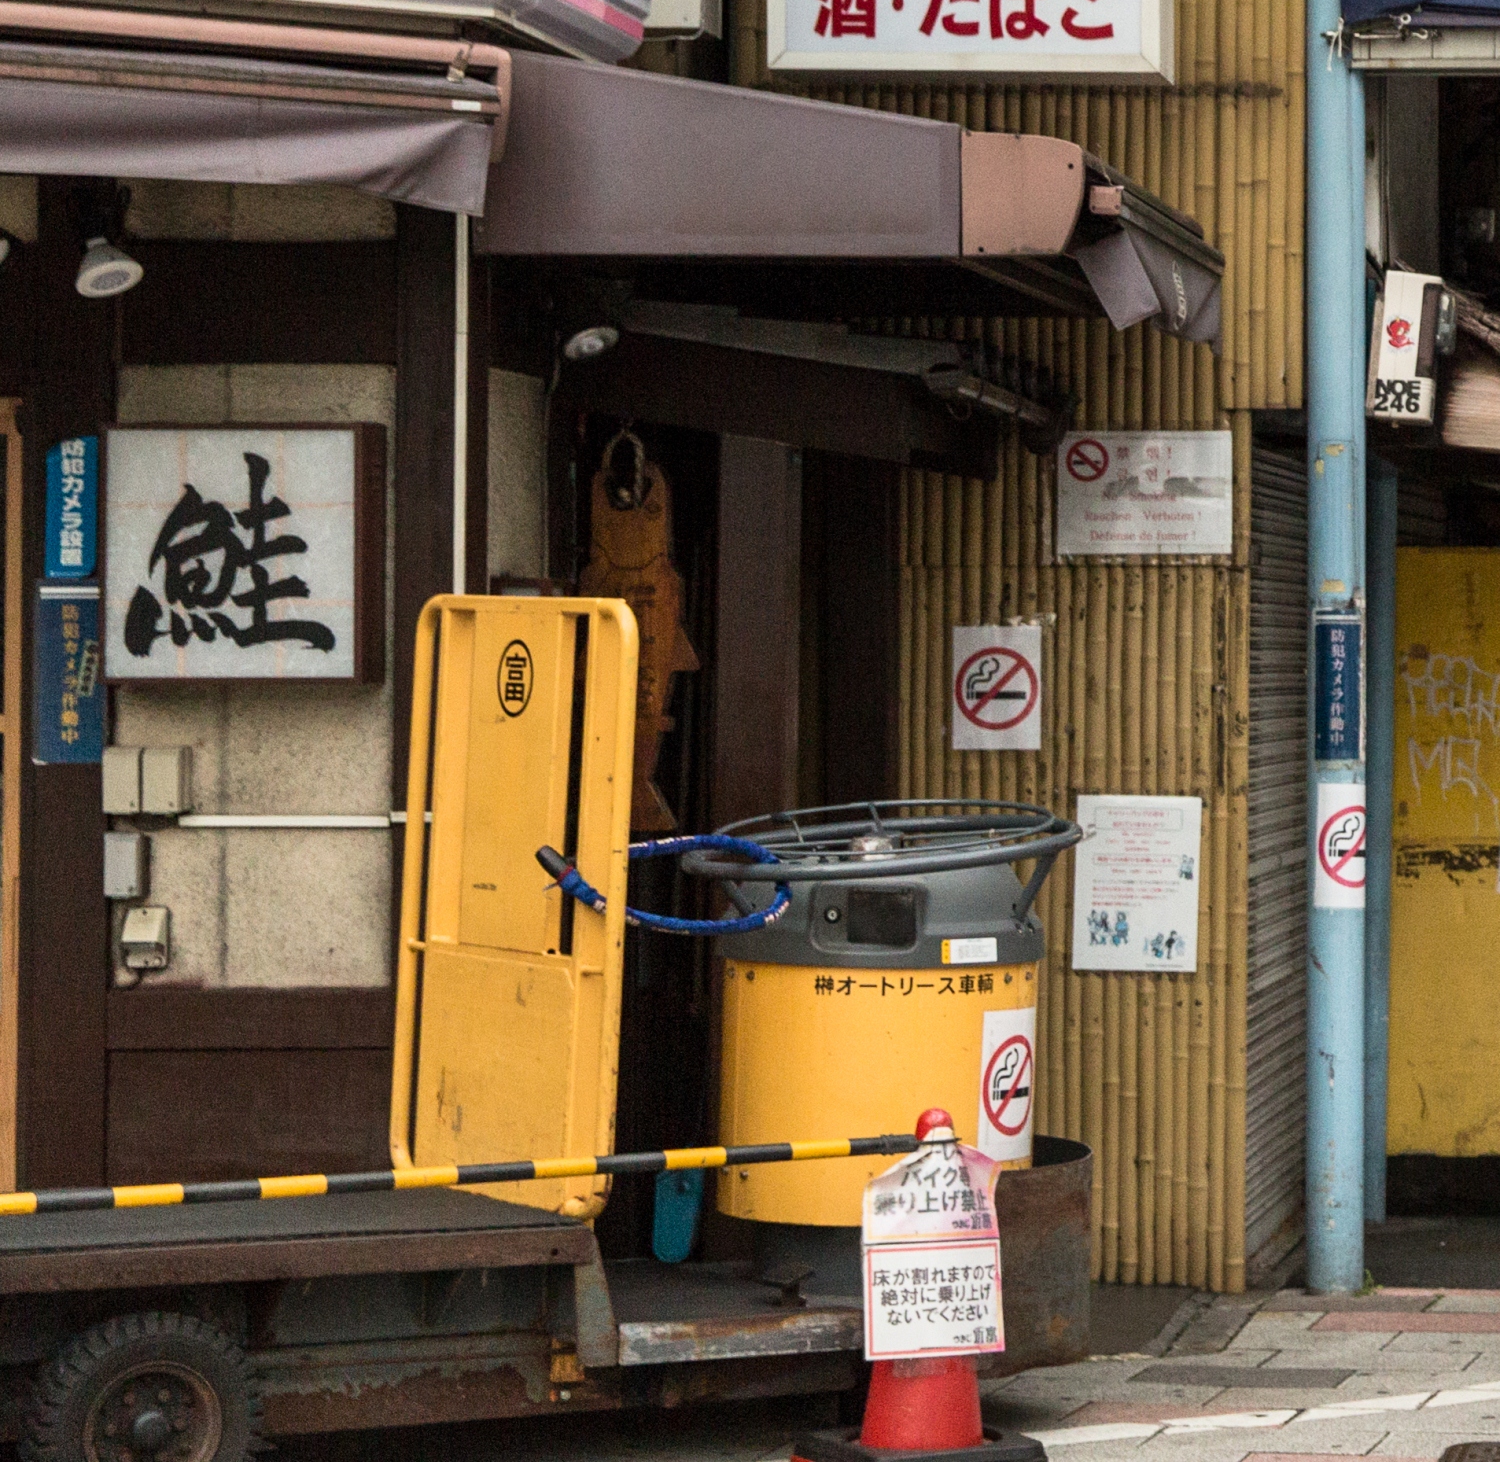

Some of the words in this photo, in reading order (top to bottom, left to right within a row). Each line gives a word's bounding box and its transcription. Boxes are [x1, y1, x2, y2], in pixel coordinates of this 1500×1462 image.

[1376, 379, 1421, 400] NOE
[1374, 394, 1420, 413] 246
[125, 452, 336, 657] 鮭
[1330, 628, 1346, 746] 防犯カメラ作動中
[873, 1188, 989, 1215] 乗り上げ禁止
[871, 1263, 996, 1288] 床が割れますので
[880, 1283, 991, 1307] 絶対に乗り上げ
[887, 1304, 989, 1326] ないでください
